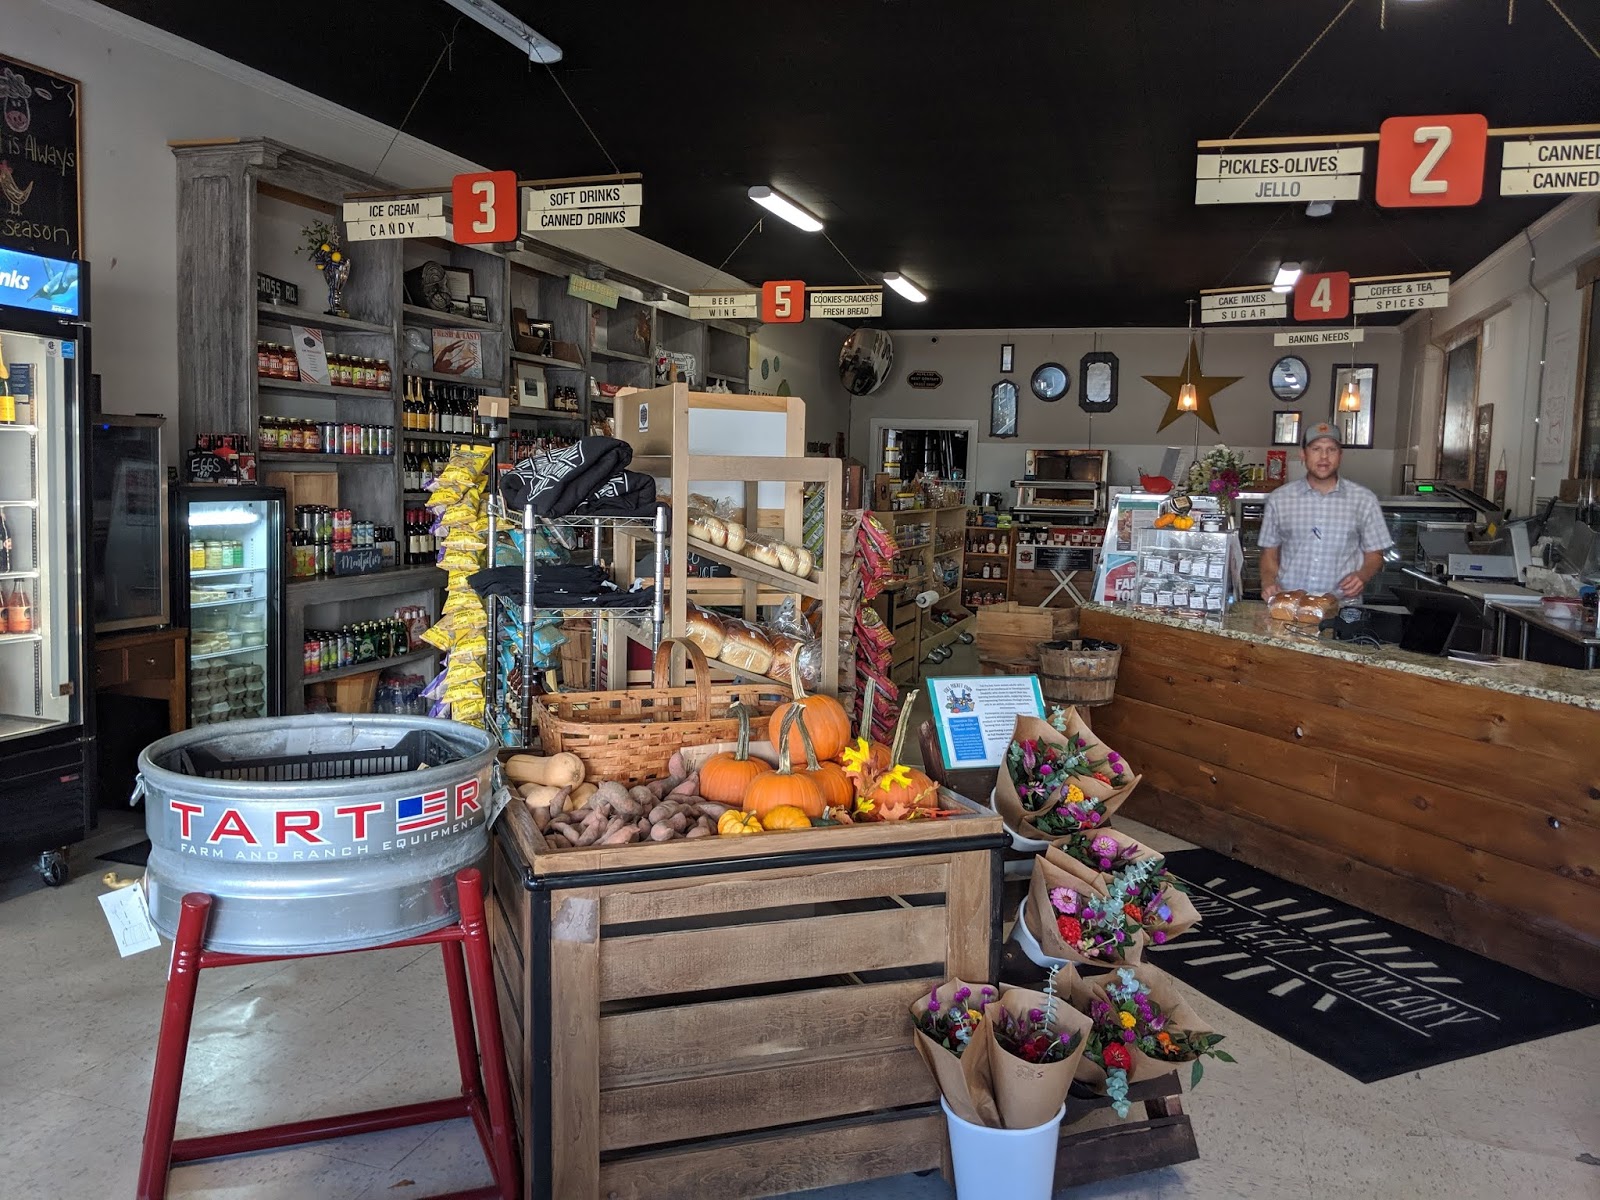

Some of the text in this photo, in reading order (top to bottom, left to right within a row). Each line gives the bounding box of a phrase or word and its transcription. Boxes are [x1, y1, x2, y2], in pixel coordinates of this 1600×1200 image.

[25, 134, 75, 177] Always
[1409, 125, 1453, 195] 2
[1218, 156, 1338, 175] PICKLES-OLIVES
[1532, 169, 1600, 189] CANNED
[549, 187, 621, 207] SOFT DRINKS
[1254, 180, 1302, 199] JELLO
[368, 202, 421, 218] ICE CREAM
[471, 180, 497, 234] 3
[540, 210, 627, 228] CANNED DRINKS
[2, 218, 70, 246] season
[369, 222, 416, 237] CANDY
[0, 266, 31, 295] nks
[1370, 282, 1433, 296] COFFEE & TEA
[711, 297, 735, 305] BEER
[774, 285, 792, 318] 5
[813, 294, 880, 304] COOKIES-CRACKERS
[1218, 293, 1266, 306] CAKE MIXES
[1310, 277, 1332, 313] 4
[1376, 297, 1425, 310] SPICES
[709, 308, 737, 317] WINE
[822, 307, 869, 316] FRESH BREAD
[1221, 308, 1267, 320] SUGAR
[1288, 332, 1350, 344] BAKING NEEDS
[191, 457, 221, 473] EGGS
[181, 816, 475, 860] FARM AND RANCH EQUIPMENT
[1214, 919, 1324, 955] MEAT
[1307, 960, 1482, 1028] COMPANY
